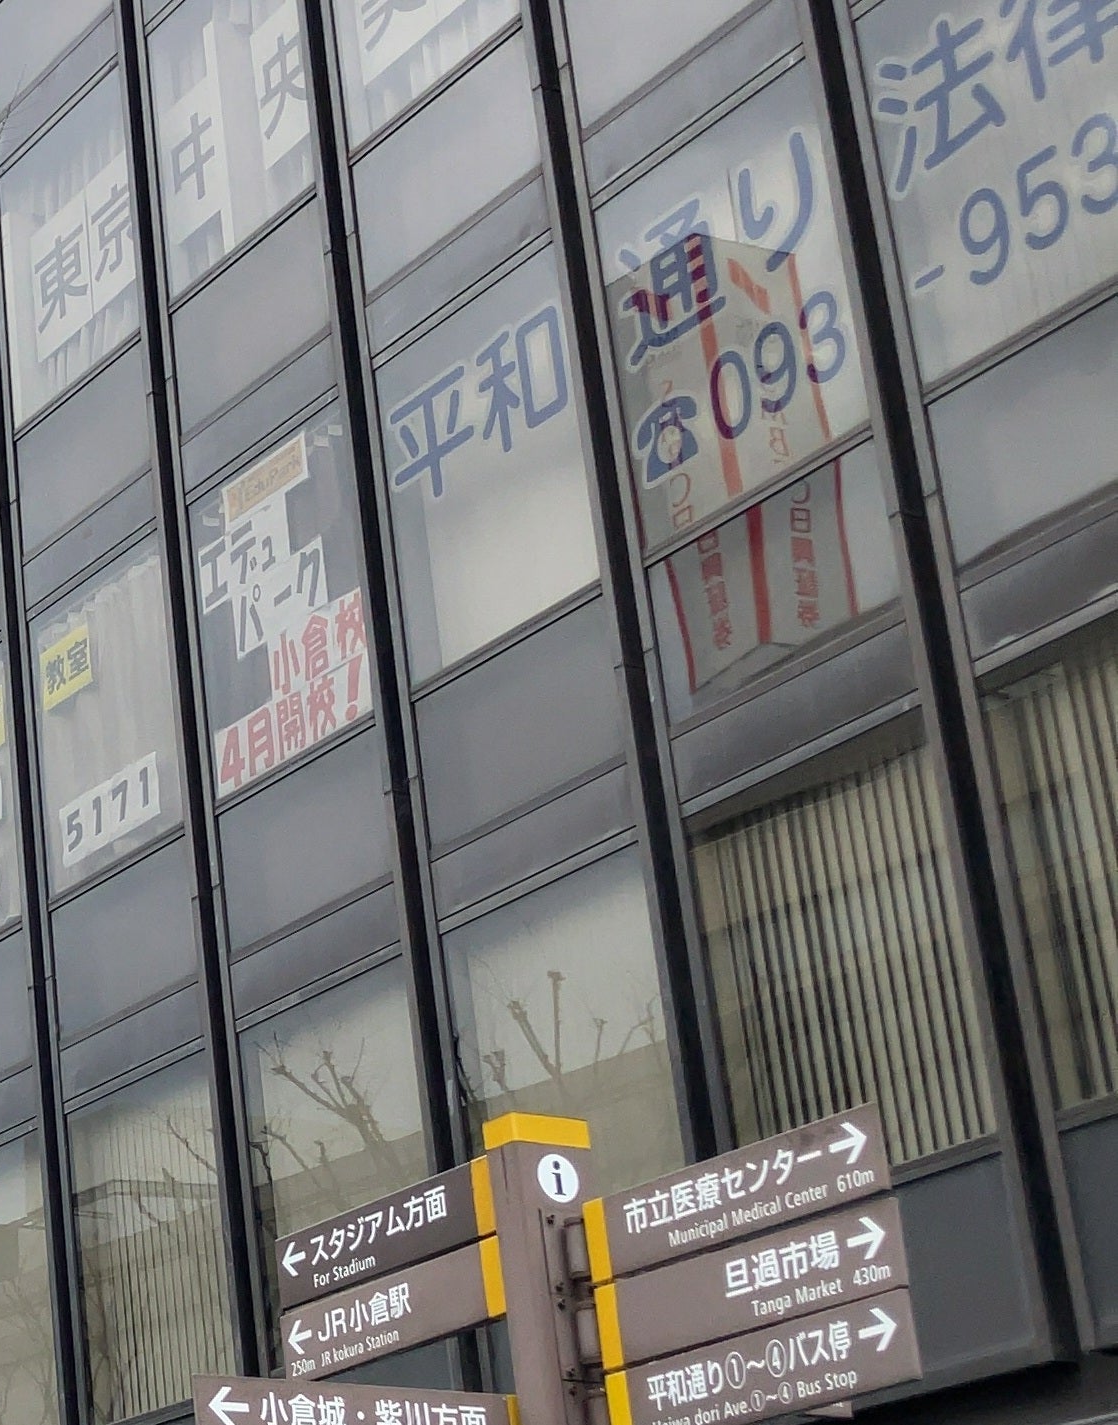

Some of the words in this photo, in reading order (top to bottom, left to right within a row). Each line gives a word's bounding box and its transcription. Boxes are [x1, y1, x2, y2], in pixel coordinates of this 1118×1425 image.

[34, 183, 133, 334] 東京
[390, 306, 569, 498] 平和
[618, 132, 813, 366] 通り
[709, 290, 846, 440] 093
[66, 765, 152, 853] 5171
[310, 1185, 447, 1266] スタジアム方面
[623, 1148, 823, 1234] 市立医療センター
[668, 1212, 729, 1248] Municipal
[732, 1195, 782, 1226] Medical
[784, 1182, 828, 1210] Center
[836, 1168, 875, 1194] 610m
[313, 1272, 331, 1288] For
[333, 1255, 376, 1282] Stadium
[725, 1230, 840, 1298] 旦過市場
[751, 1294, 792, 1317] Tanga
[796, 1278, 843, 1305] Market
[853, 1263, 891, 1286] 430m
[317, 1282, 412, 1342] JR小倉駅
[321, 1353, 332, 1368] JR
[333, 1342, 364, 1363] kokura
[366, 1330, 400, 1351] Station
[694, 1405, 721, 1425] dori
[797, 1379, 822, 1399] Bus
[824, 1369, 858, 1391] Stop
